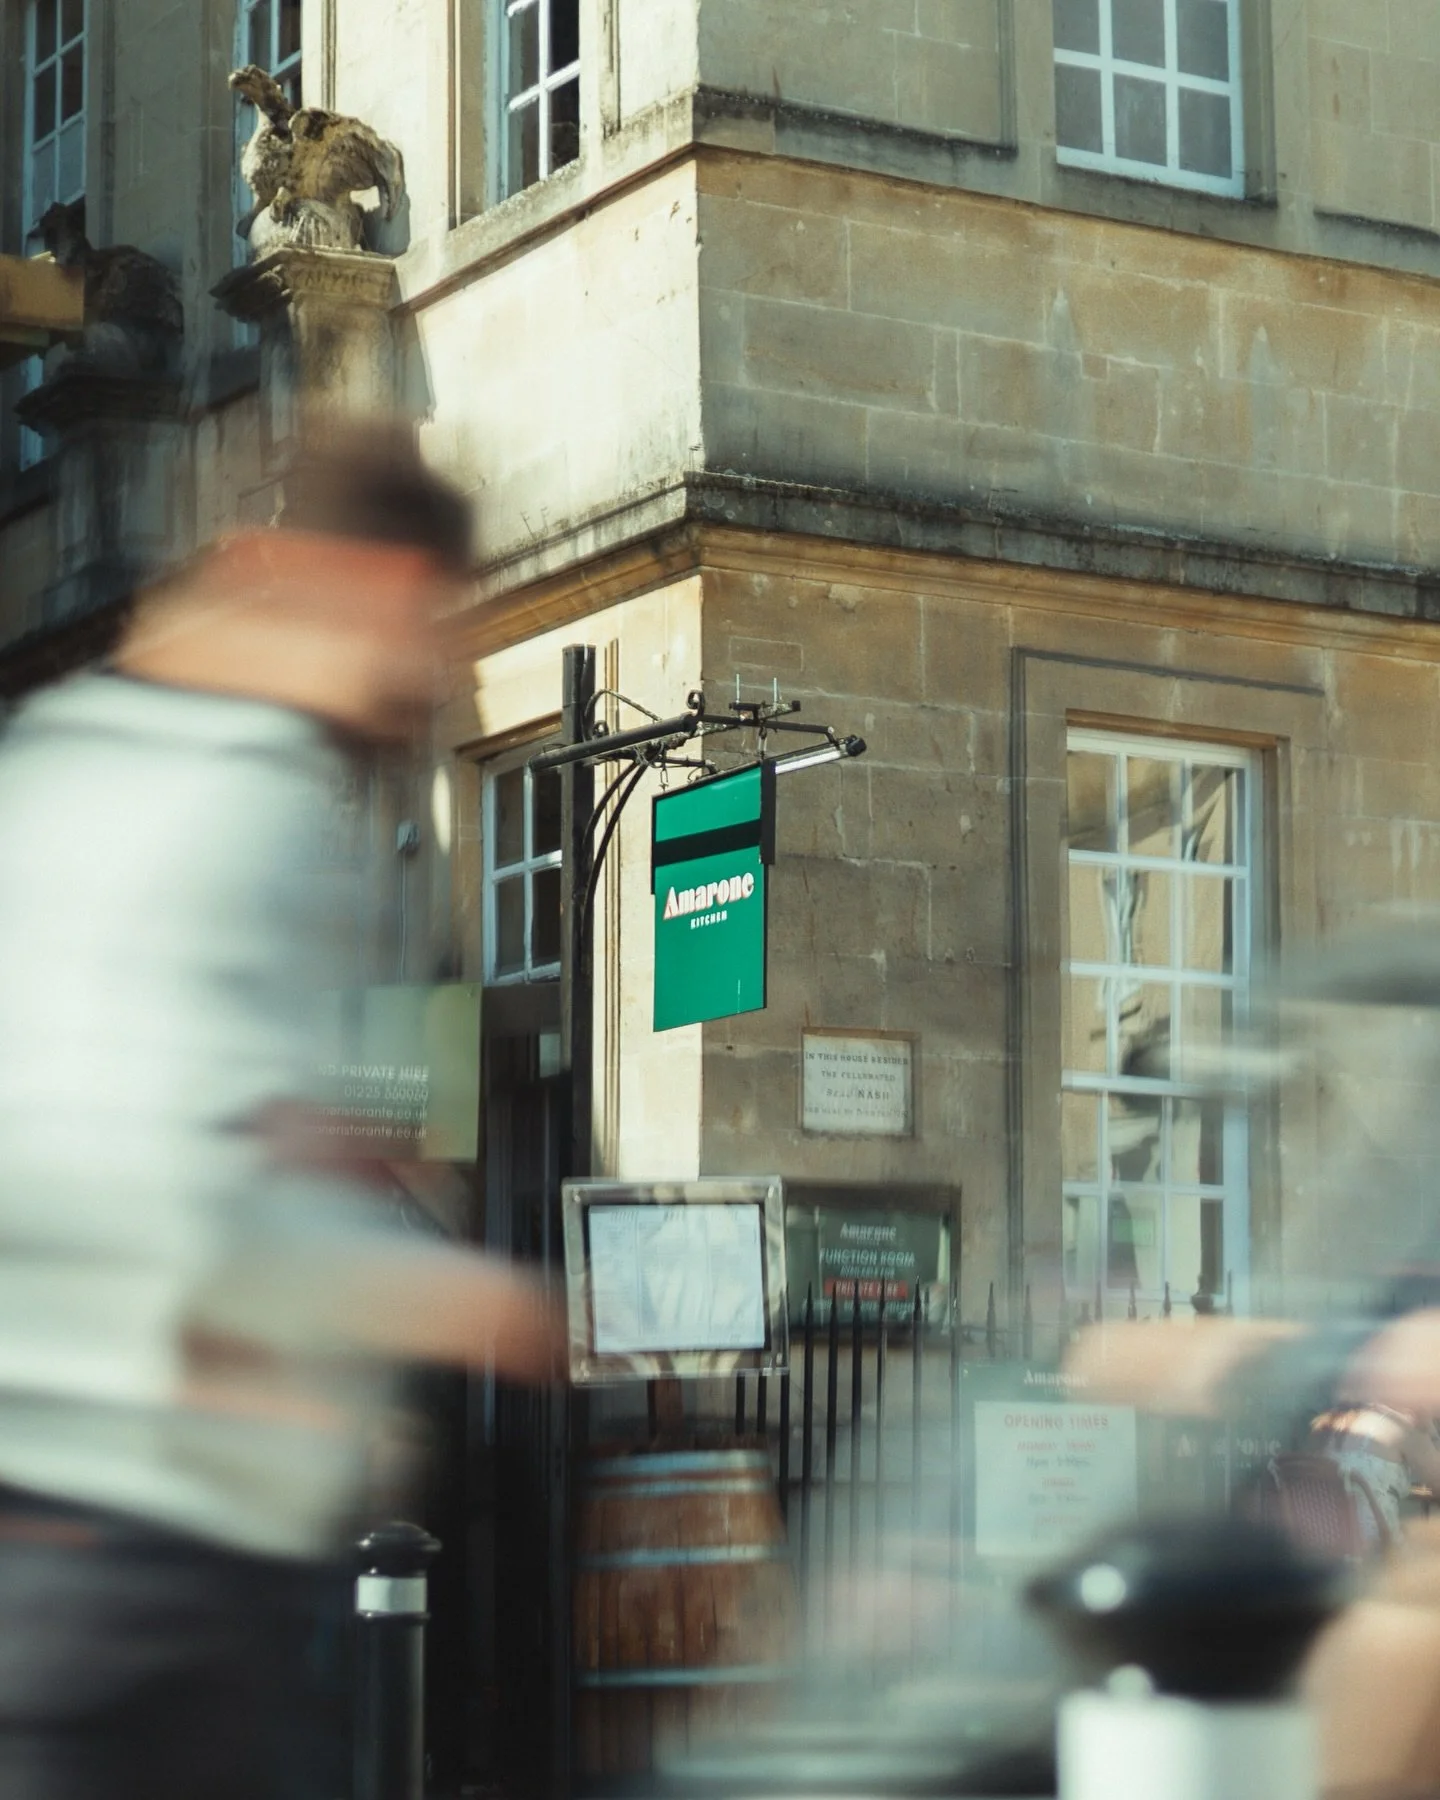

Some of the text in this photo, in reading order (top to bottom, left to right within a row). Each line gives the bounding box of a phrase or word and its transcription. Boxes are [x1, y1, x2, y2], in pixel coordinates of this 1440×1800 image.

[663, 872, 754, 920] Amarone
[690, 910, 728, 930] KITCHEN
[805, 1052, 815, 1061] IN
[818, 1052, 838, 1062] THIS
[840, 1054, 868, 1064] HOUSE
[341, 1064, 395, 1080] PRIVATE
[398, 1064, 430, 1082] HIRE
[821, 1070, 837, 1079] THE
[344, 1084, 380, 1099] 01225
[820, 1248, 916, 1269] FUNCTION ROOM
[1004, 1413, 1110, 1431] OPENING TIMES
